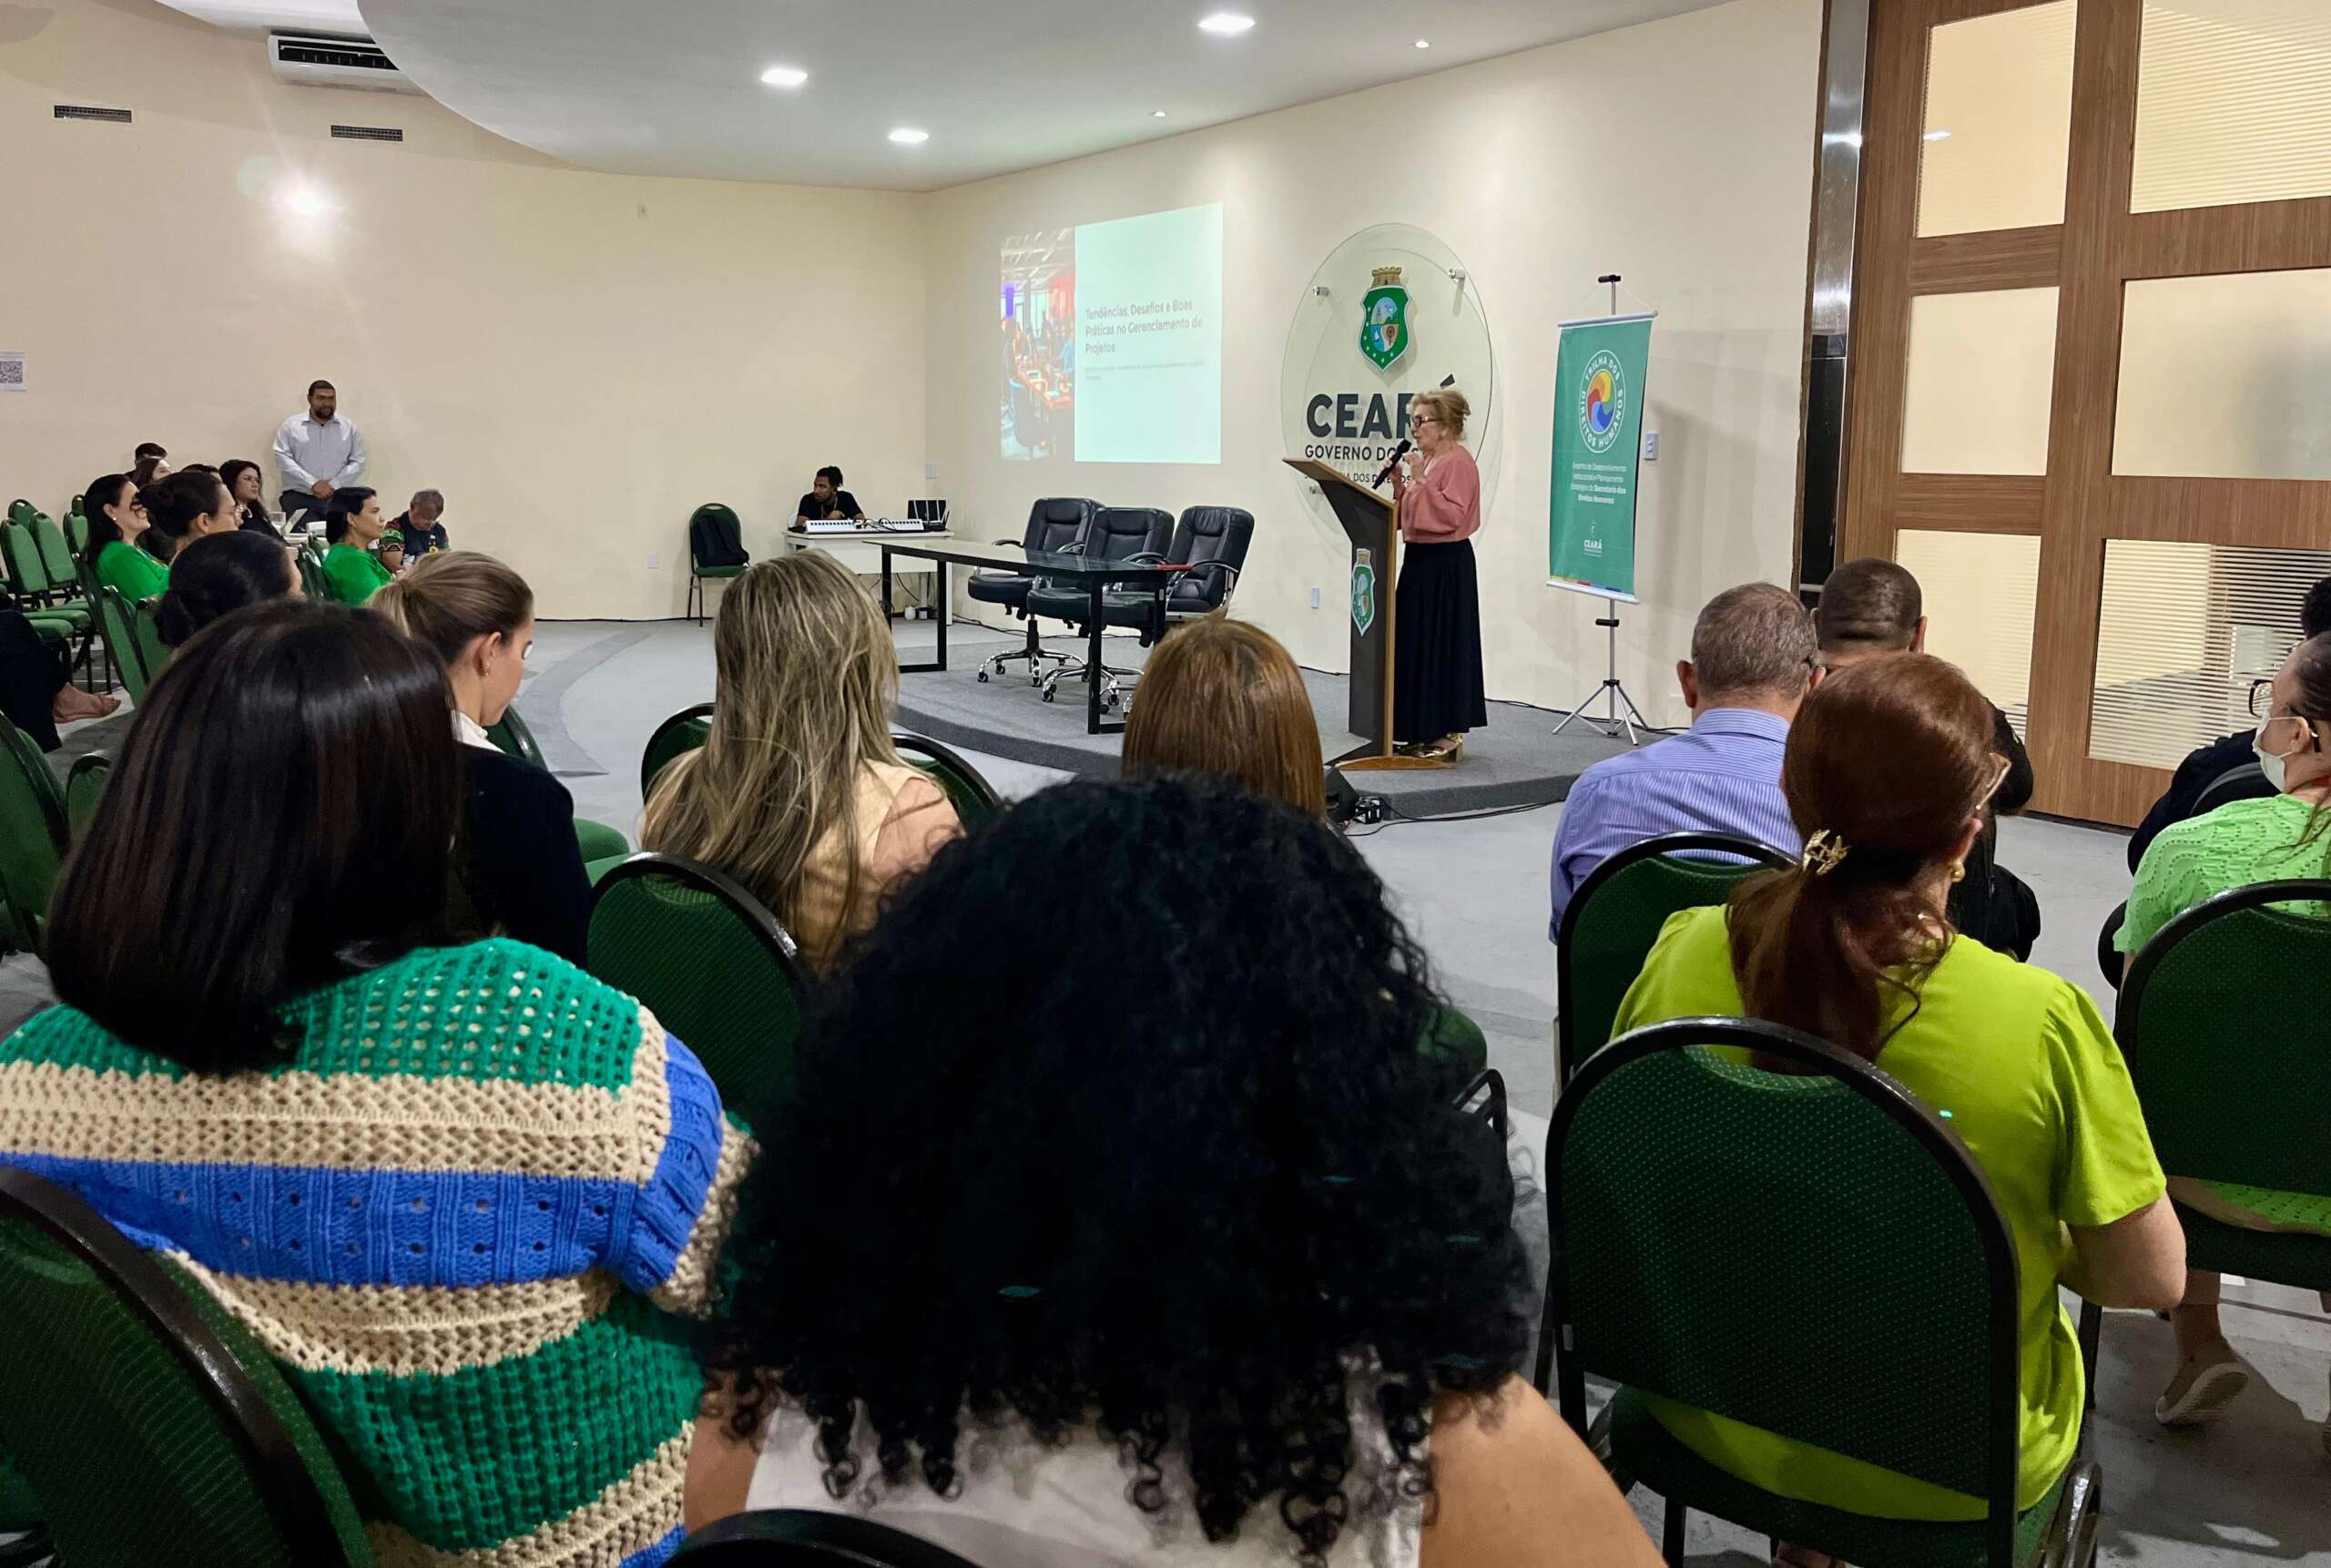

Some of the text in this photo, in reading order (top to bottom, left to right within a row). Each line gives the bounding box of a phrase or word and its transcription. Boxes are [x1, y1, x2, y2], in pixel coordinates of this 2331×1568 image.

[1131, 301, 1164, 315] Desafios
[1116, 325, 1127, 335] no
[1085, 342, 1115, 356] Projetos
[1585, 356, 1621, 381] TRILHA DOS
[1581, 390, 1623, 448] DIREITOS HUMANOS
[1305, 444, 1372, 461] GOVERNO
[1354, 473, 1370, 483] DOS
